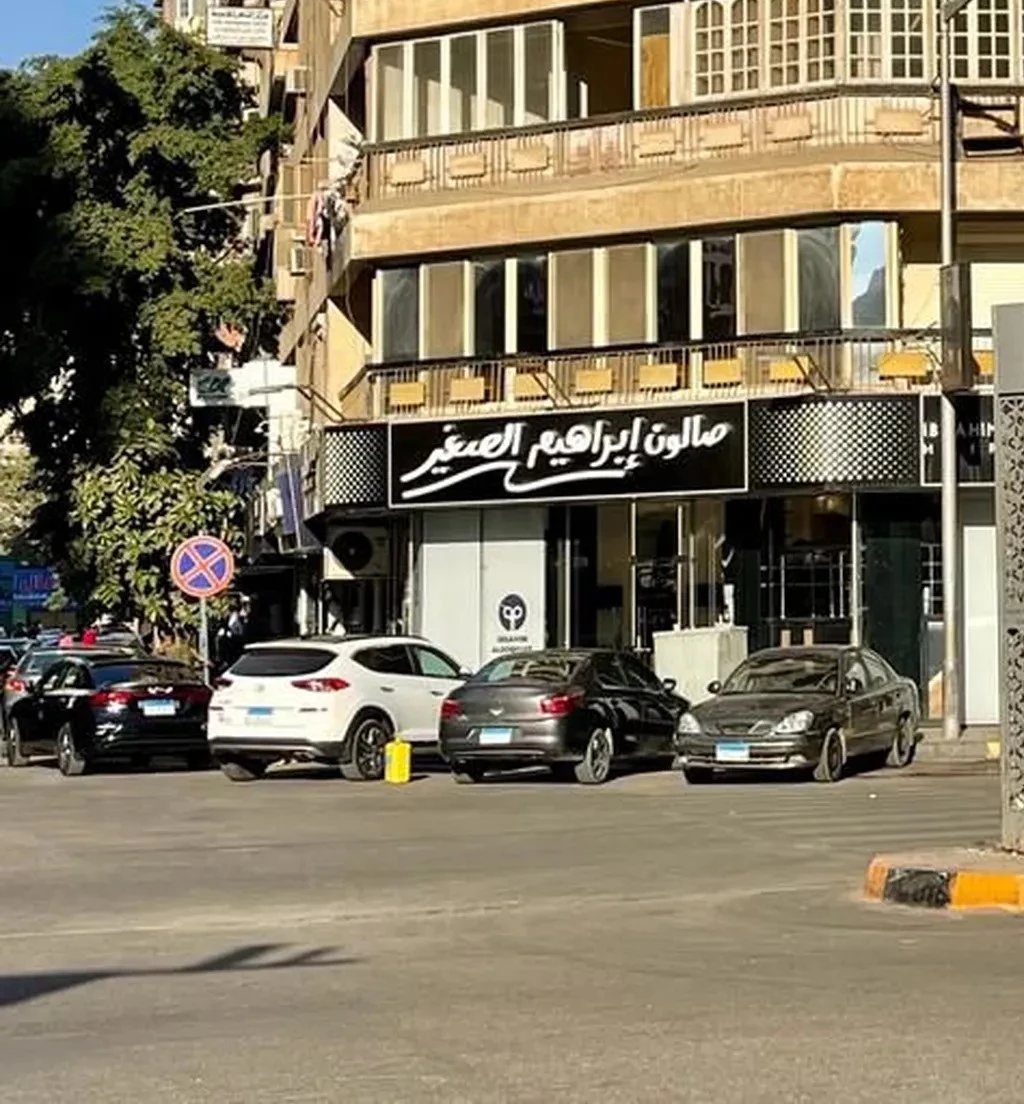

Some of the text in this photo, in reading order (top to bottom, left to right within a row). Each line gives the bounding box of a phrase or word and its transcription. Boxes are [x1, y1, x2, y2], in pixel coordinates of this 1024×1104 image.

[400, 414, 733, 482] صالون إبراهيم الصغير
